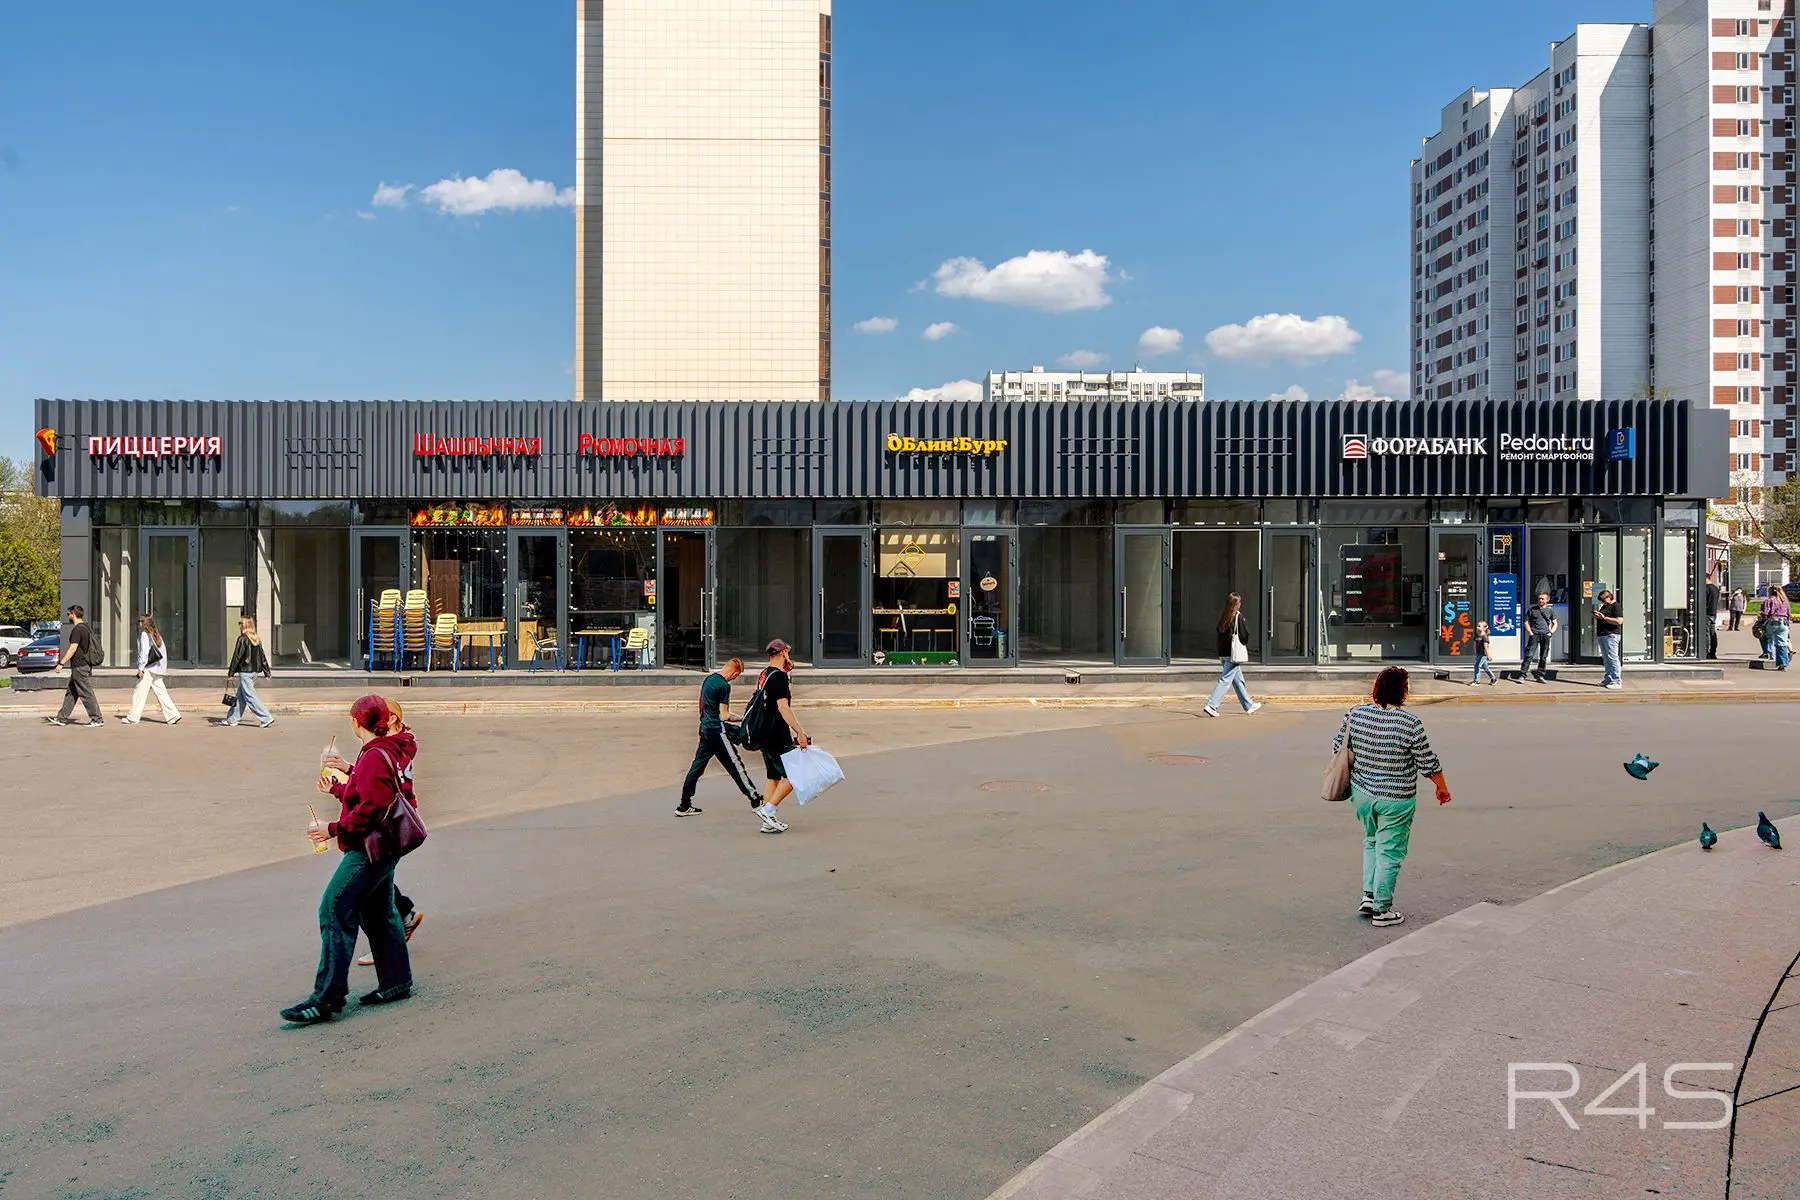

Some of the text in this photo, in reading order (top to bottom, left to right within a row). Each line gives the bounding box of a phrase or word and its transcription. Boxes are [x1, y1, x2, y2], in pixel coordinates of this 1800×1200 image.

[88, 436, 222, 457] ПИЦЦЕРИЯ
[1372, 437, 1487, 455] ФОРАБАНК
[1500, 433, 1594, 451] Pedant.ru
